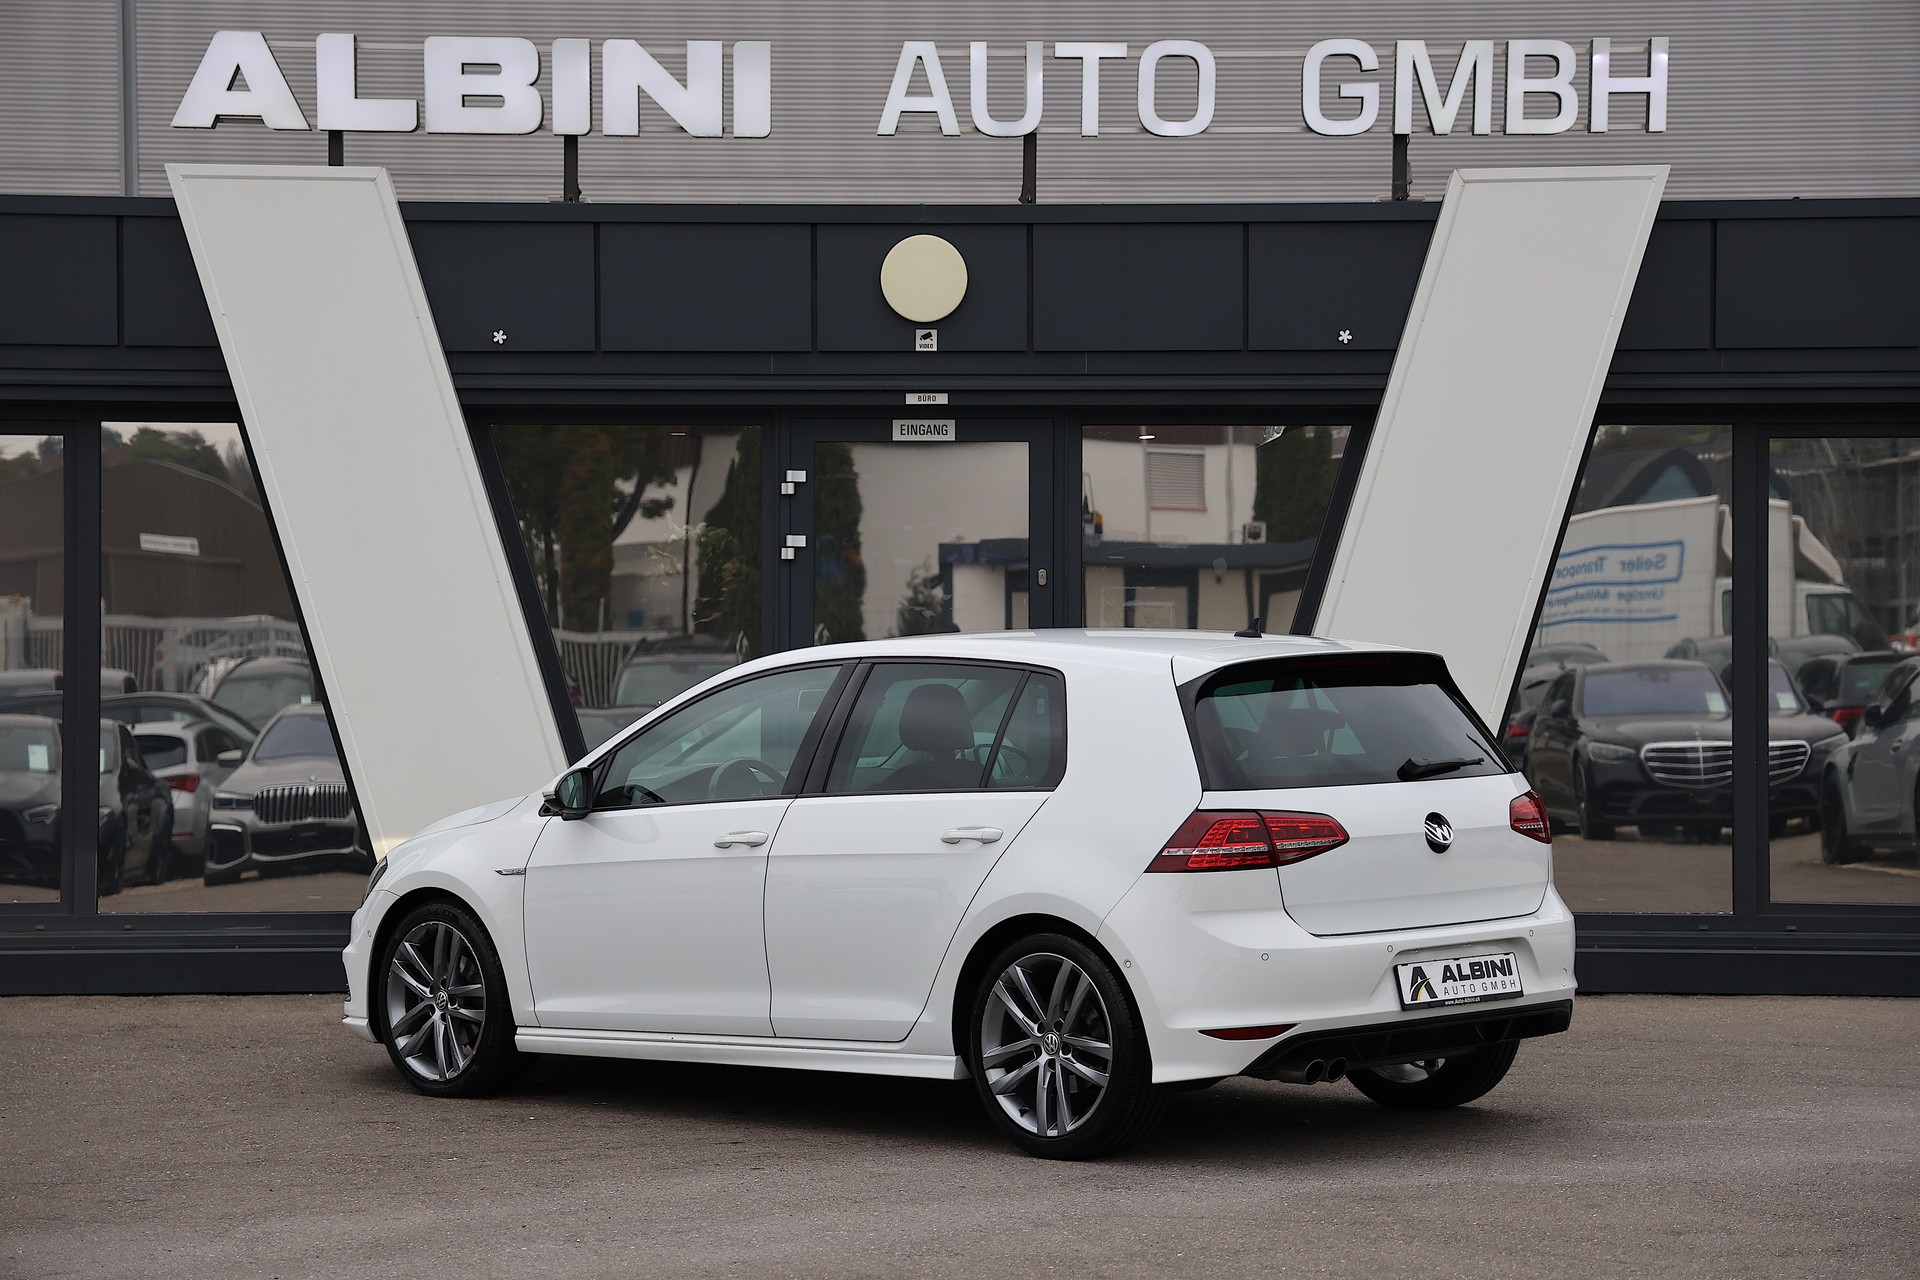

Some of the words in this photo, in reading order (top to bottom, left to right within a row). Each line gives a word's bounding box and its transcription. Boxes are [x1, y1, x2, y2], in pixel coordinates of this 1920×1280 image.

[170, 30, 772, 138] ALBINI
[876, 38, 1217, 138] AUTO
[1301, 35, 1669, 137] GMBH
[917, 394, 937, 402] BÜRO
[900, 424, 948, 436] EINGANG
[1441, 958, 1513, 983] ALBINI
[1443, 983, 1476, 996] AUTO
[1482, 979, 1516, 992] GMBH
